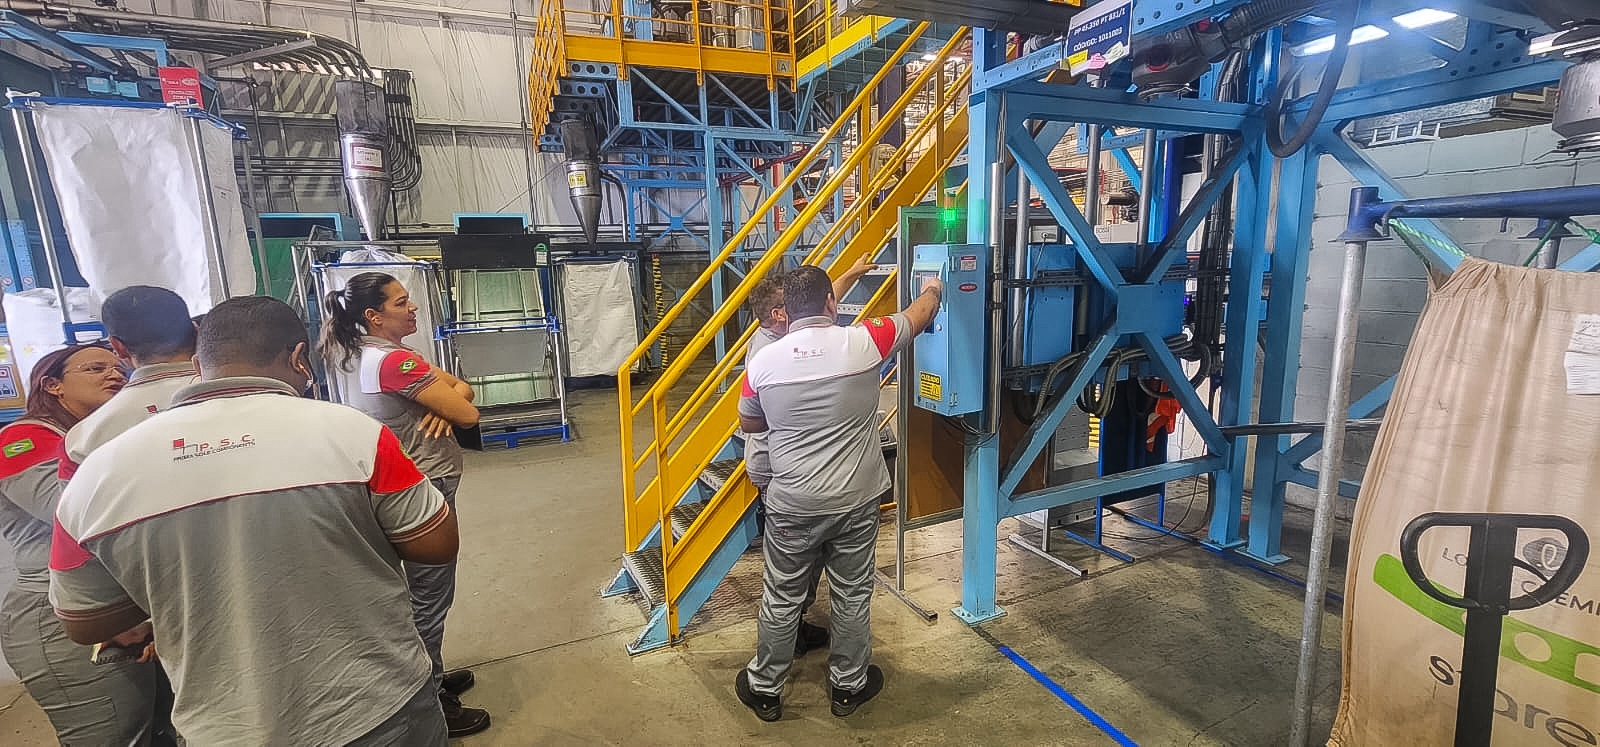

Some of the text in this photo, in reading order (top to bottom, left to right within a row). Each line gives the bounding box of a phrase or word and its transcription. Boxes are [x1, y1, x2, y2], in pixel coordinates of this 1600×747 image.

[200, 434, 255, 452] P. S. C.
